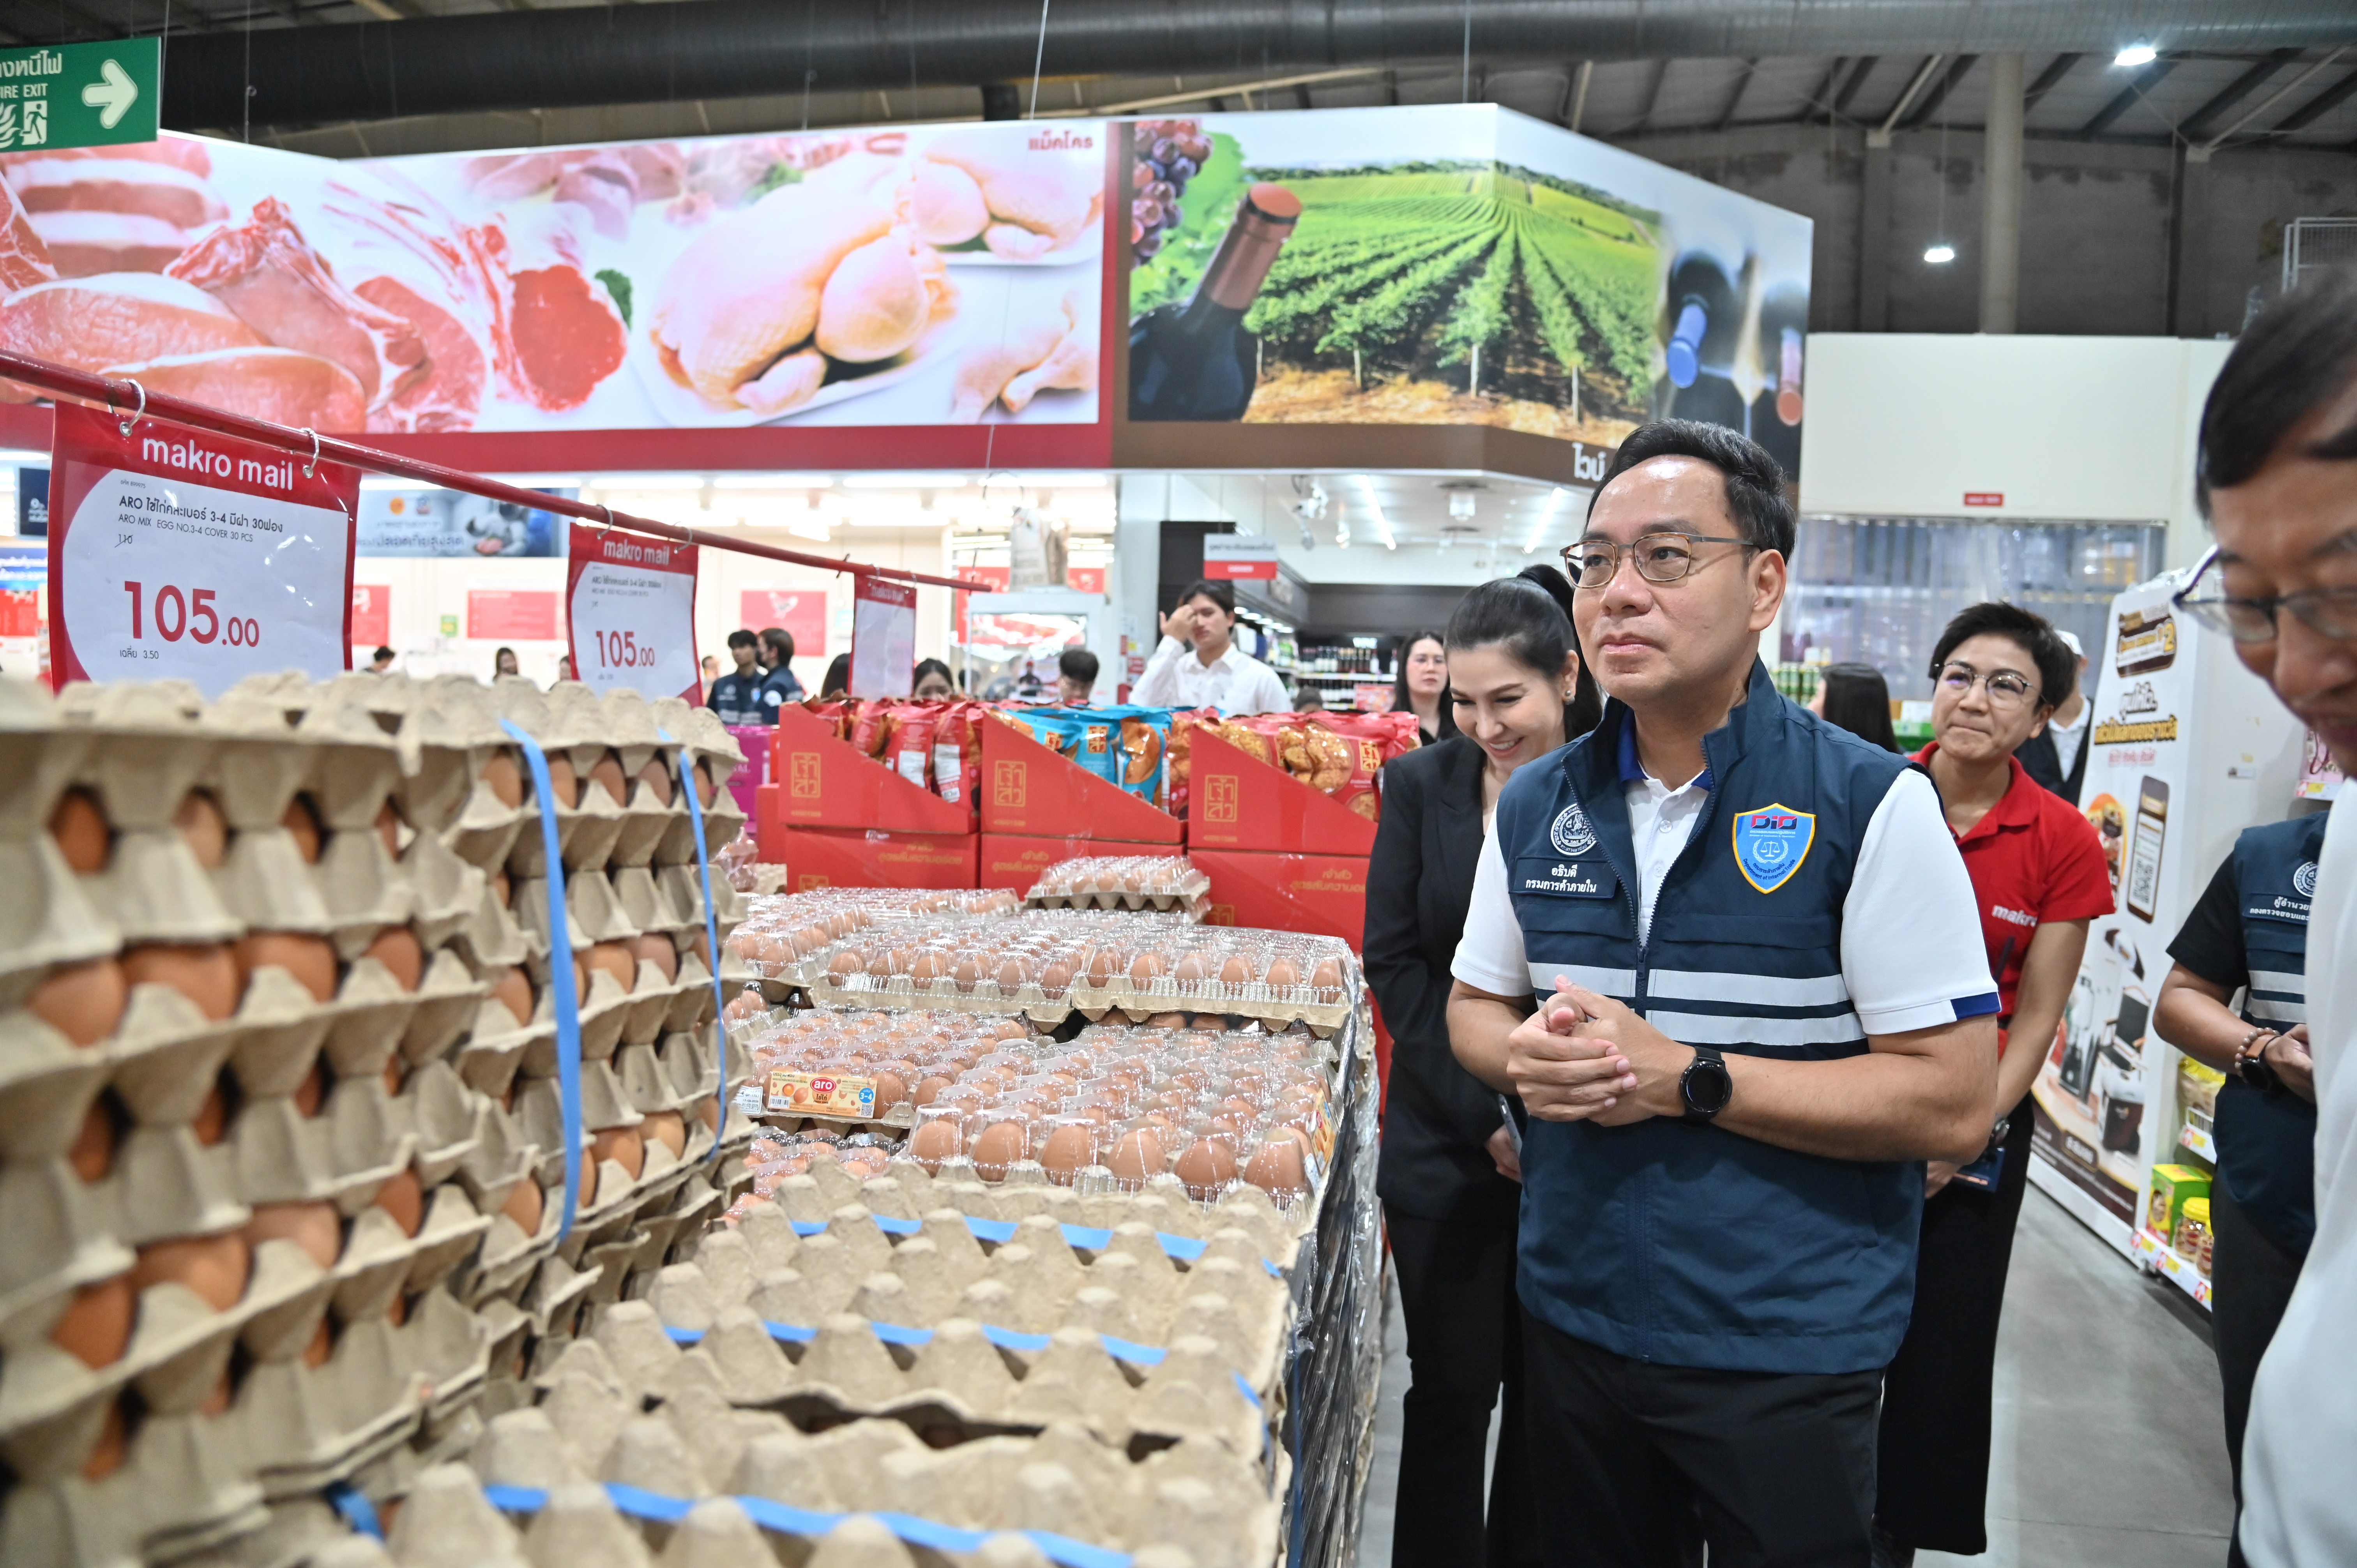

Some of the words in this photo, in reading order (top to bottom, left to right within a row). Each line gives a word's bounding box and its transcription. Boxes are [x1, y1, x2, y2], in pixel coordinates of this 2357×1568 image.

[0, 85, 19, 98] IRE
[23, 83, 48, 97] EXIT
[143, 438, 231, 477] makro
[239, 459, 293, 490] mail
[119, 496, 143, 509] ARO
[210, 511, 226, 523] 3-4
[230, 513, 248, 527] มีฝา
[252, 519, 283, 533] 30ฟอง
[118, 514, 136, 524] ARO
[138, 516, 152, 526] MIX
[157, 519, 174, 530] EGG
[177, 524, 202, 535] NO.3-4
[205, 527, 228, 539] COVER
[231, 531, 239, 540] 30
[241, 533, 253, 542] PCS
[604, 539, 642, 562] makro
[644, 546, 670, 565] mail
[125, 581, 260, 647] 105.00
[143, 650, 159, 659] 3.50
[595, 630, 655, 667] 105.00
[1551, 864, 1578, 878] อธิบดี
[1743, 858, 1762, 879] Department
[1768, 869, 1786, 879] Internal
[1785, 859, 1795, 871] Trade
[1525, 879, 1597, 893] กรมการค้าภายใน
[2274, 896, 2312, 911] ผู้อำนวย
[814, 1080, 832, 1090] aro
